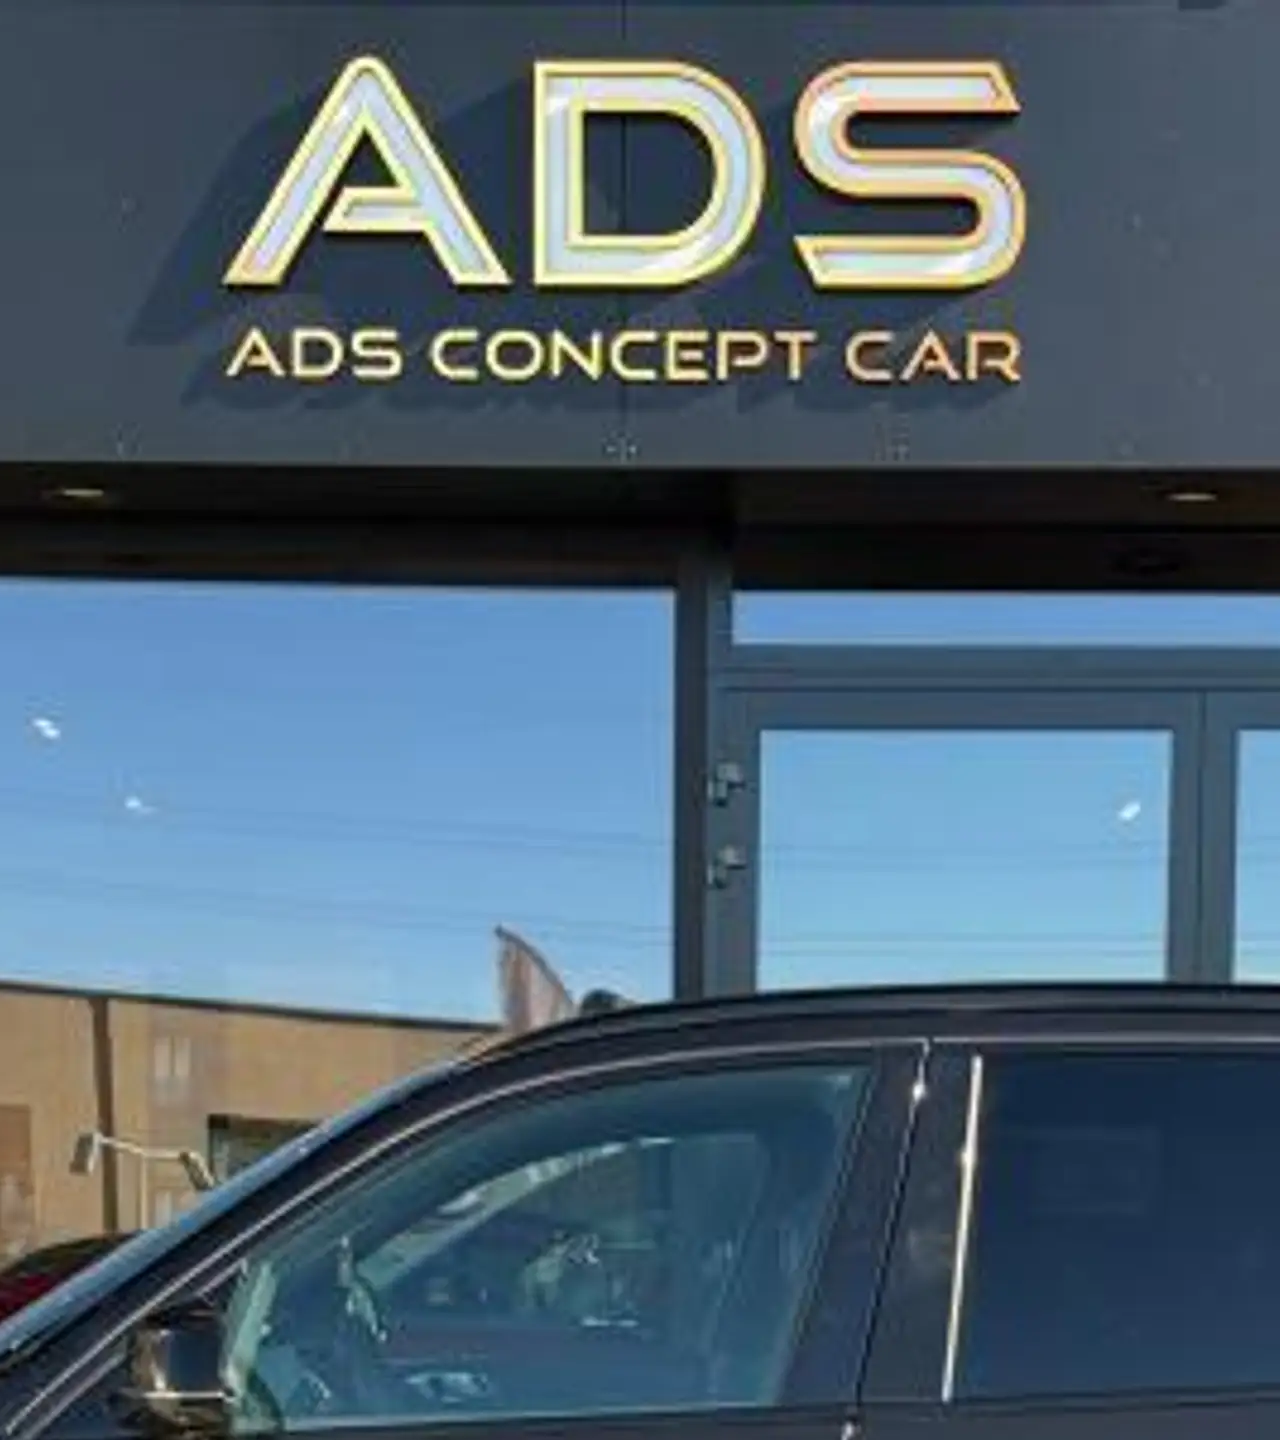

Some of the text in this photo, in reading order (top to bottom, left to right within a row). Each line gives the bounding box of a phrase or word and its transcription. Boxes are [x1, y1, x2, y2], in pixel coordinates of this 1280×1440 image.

[222, 55, 1027, 287] ADS
[225, 328, 1023, 381] ADS CONCEPT CAR
